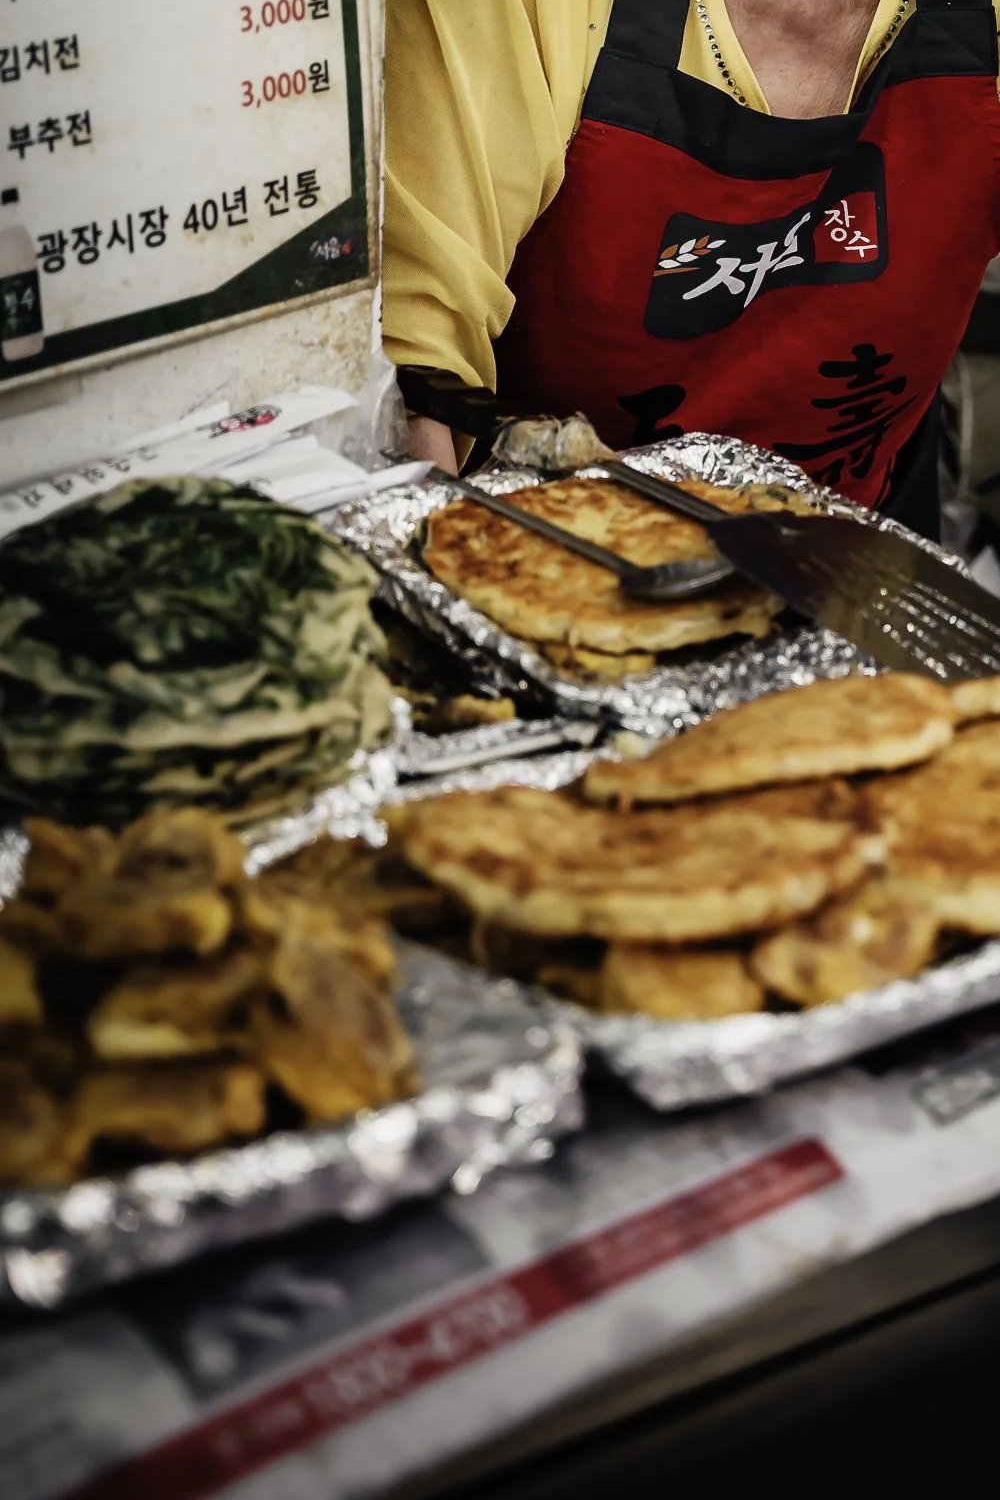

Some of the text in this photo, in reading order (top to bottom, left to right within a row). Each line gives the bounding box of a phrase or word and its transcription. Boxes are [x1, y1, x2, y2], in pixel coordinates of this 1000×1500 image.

[0, 34, 80, 84] 김치전
[241, 59, 331, 109] 3,000원
[8, 110, 92, 161] 부추전
[35, 168, 322, 275] 광장시장 40년 전통
[824, 199, 878, 258] 장수
